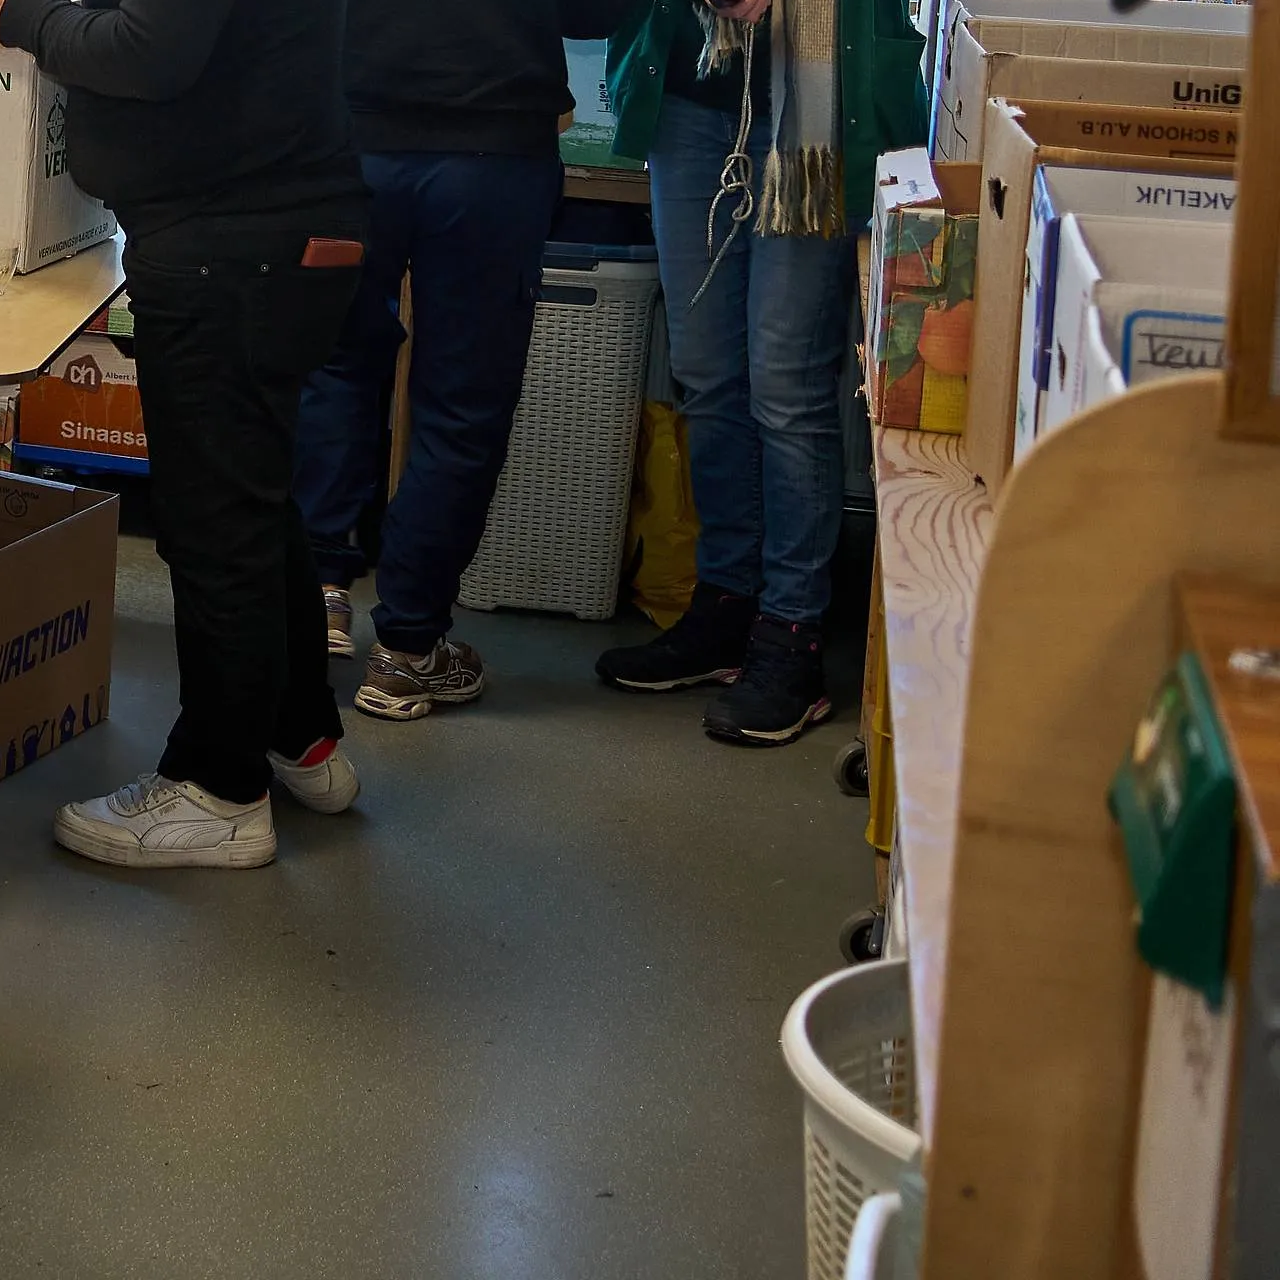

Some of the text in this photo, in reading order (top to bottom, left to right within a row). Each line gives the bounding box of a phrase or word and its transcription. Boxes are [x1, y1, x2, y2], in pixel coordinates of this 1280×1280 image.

[1173, 81, 1242, 105] UniG
[1077, 120, 1220, 144] SCHOON A.U.B.
[1136, 185, 1235, 210] AKELIJK
[39, 229, 94, 259] VERVANGINGSWAARDE
[105, 371, 129, 381] Albert
[60, 420, 147, 448] Sinaasa
